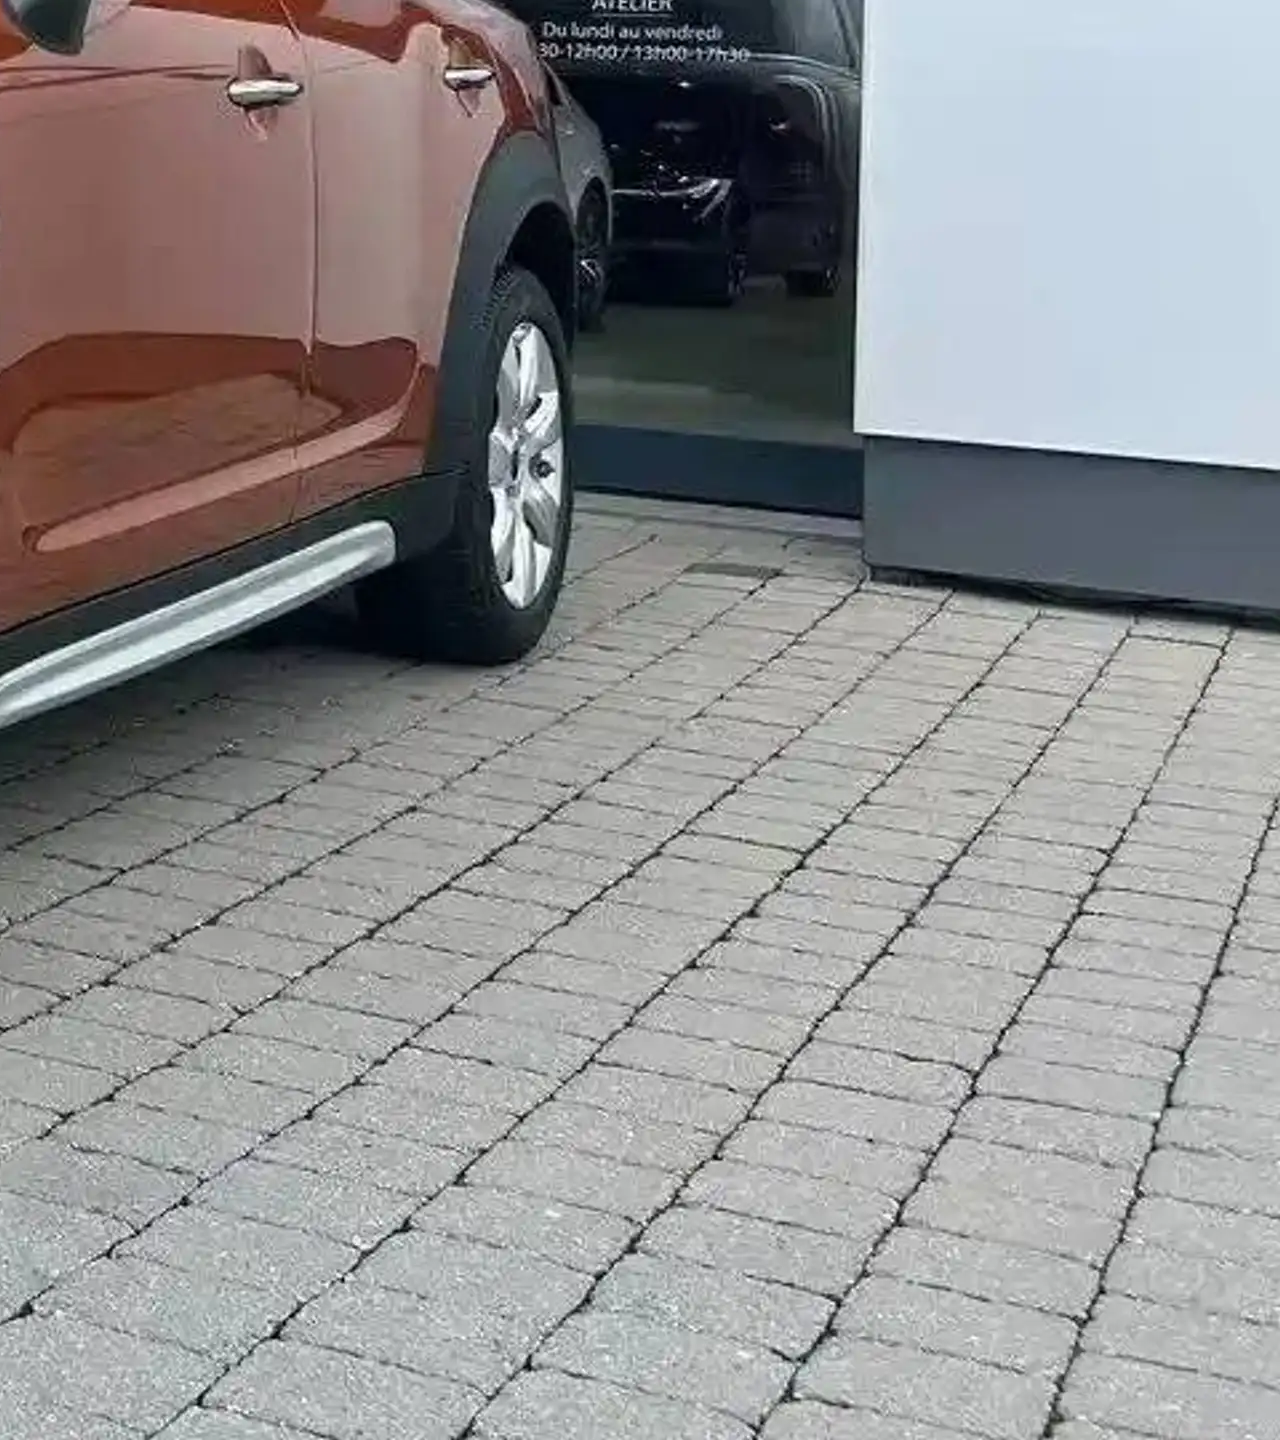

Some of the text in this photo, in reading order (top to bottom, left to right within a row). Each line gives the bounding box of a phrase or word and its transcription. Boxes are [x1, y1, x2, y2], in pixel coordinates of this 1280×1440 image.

[542, 22, 723, 41] Du lundi au vendredi
